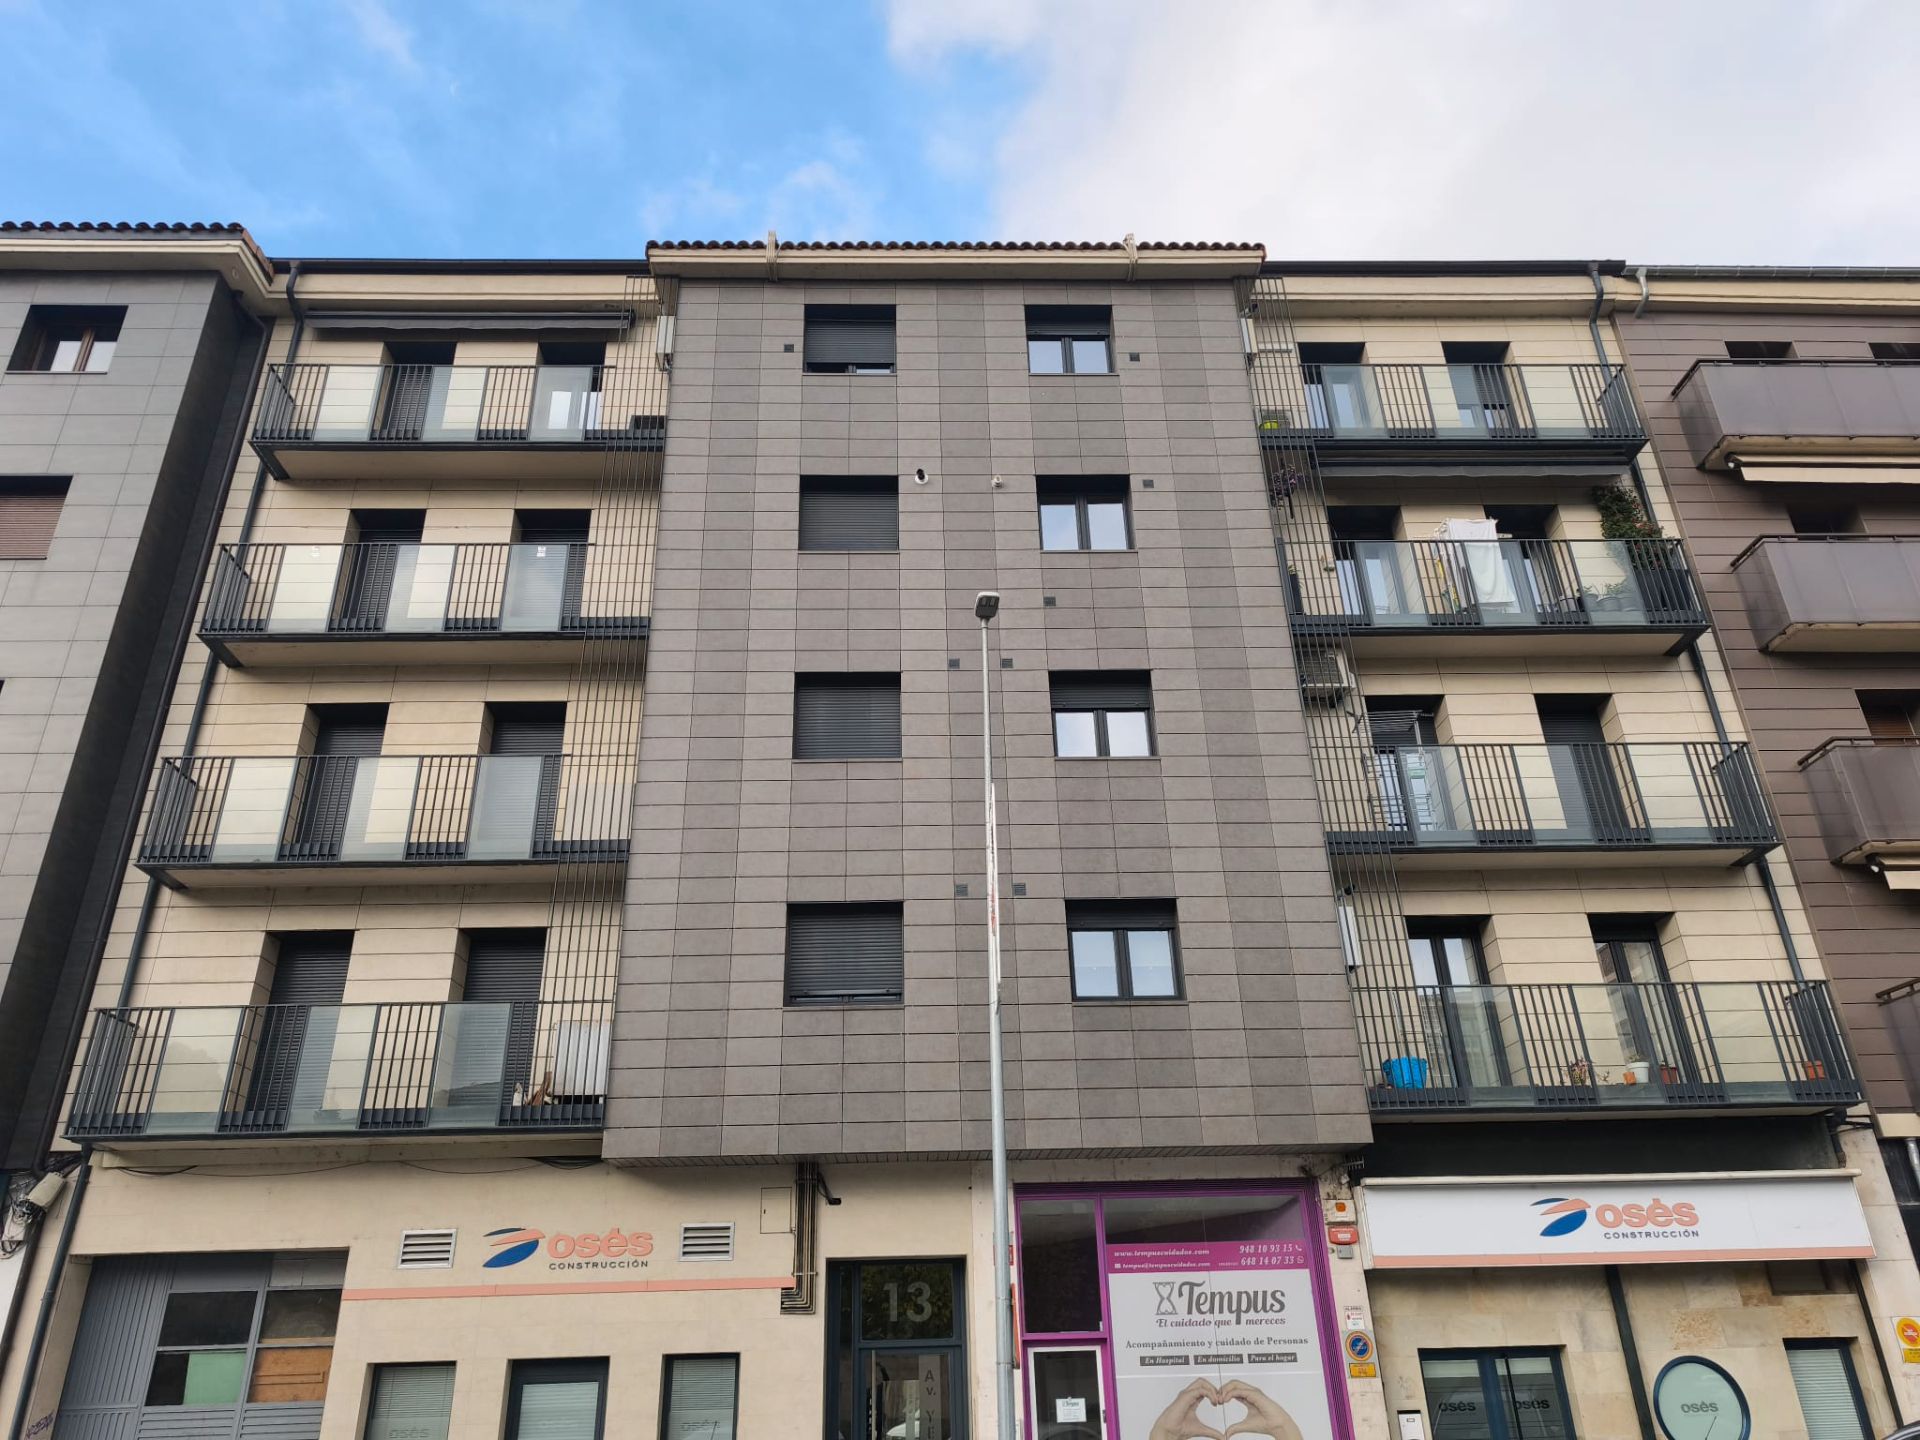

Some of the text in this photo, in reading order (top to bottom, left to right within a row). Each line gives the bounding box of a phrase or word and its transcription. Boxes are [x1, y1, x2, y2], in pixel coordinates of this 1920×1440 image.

[1595, 1198, 1699, 1228] osés
[1603, 1229, 1699, 1240] CONSTRUCCIÓN
[547, 1226, 654, 1258] osés
[1240, 1245, 1255, 1253] 948
[1270, 1244, 1280, 1253] 93
[1283, 1243, 1293, 1252] 15
[548, 1260, 649, 1270] CONSTRUCCIÓN
[1241, 1257, 1256, 1266] 648
[1260, 1256, 1269, 1265] 14
[1271, 1256, 1281, 1265] 07
[1284, 1255, 1294, 1264] 33
[883, 1281, 932, 1322] 13
[1178, 1280, 1286, 1325] Tempus
[1156, 1317, 1286, 1328] El cuidado que mereces
[1126, 1336, 1308, 1350] Acompañamiento y cuidado de Personas
[1156, 1356, 1185, 1365] Hospital
[1208, 1354, 1241, 1362] domicilio
[1681, 1401, 1719, 1413] osés
